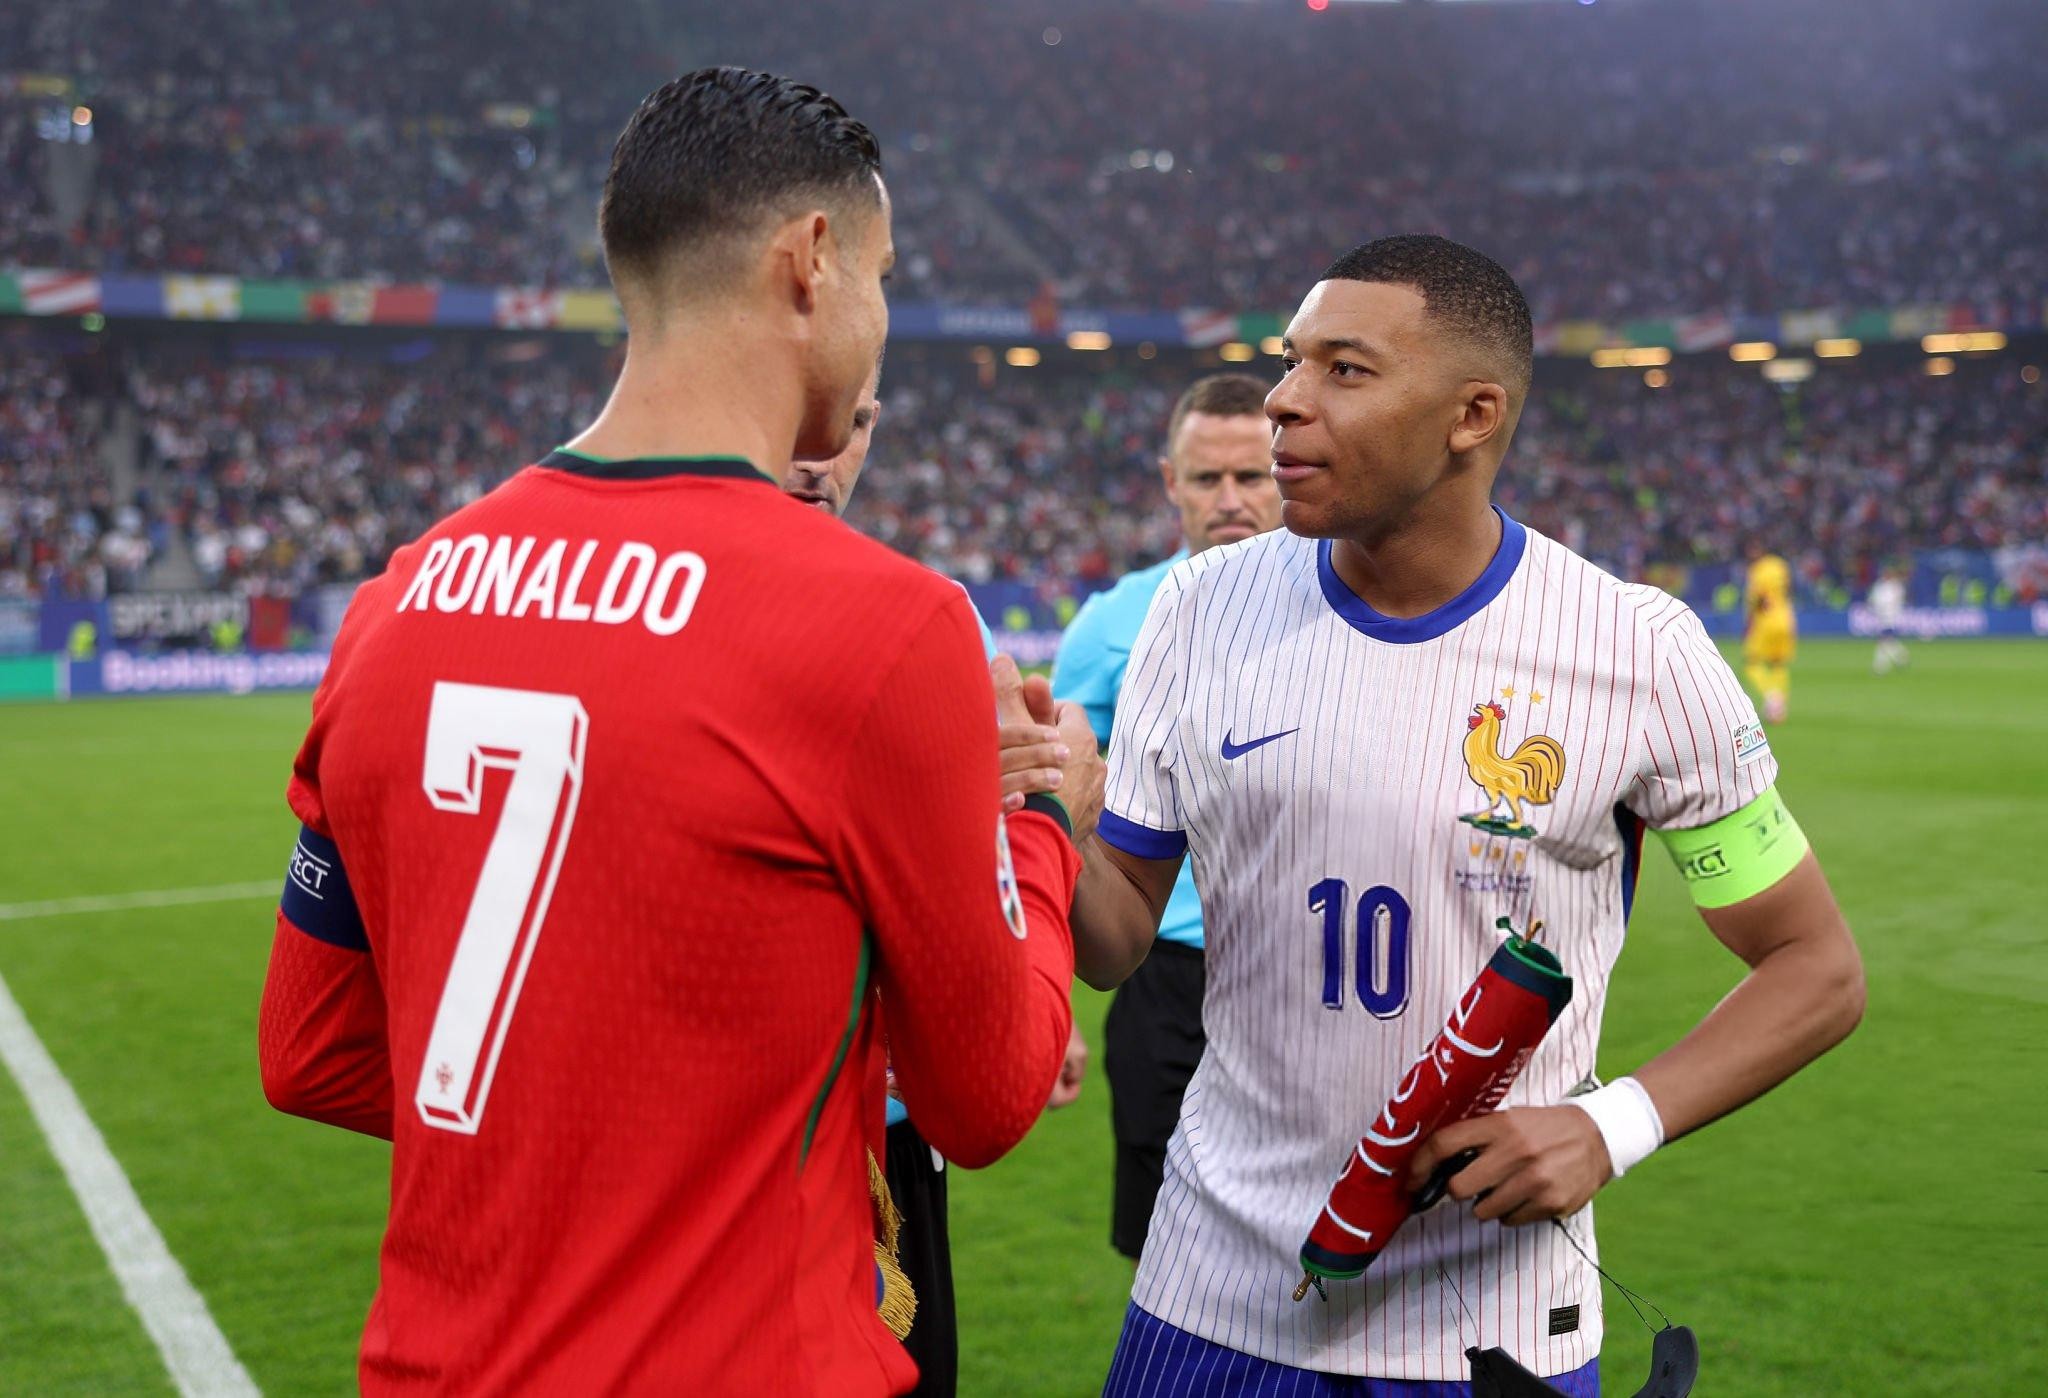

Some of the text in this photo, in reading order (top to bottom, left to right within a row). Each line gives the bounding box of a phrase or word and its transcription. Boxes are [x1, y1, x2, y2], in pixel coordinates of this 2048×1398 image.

[396, 533, 708, 637] RONALDO
[414, 679, 590, 1136] 7
[1307, 876, 1412, 1021] 10
